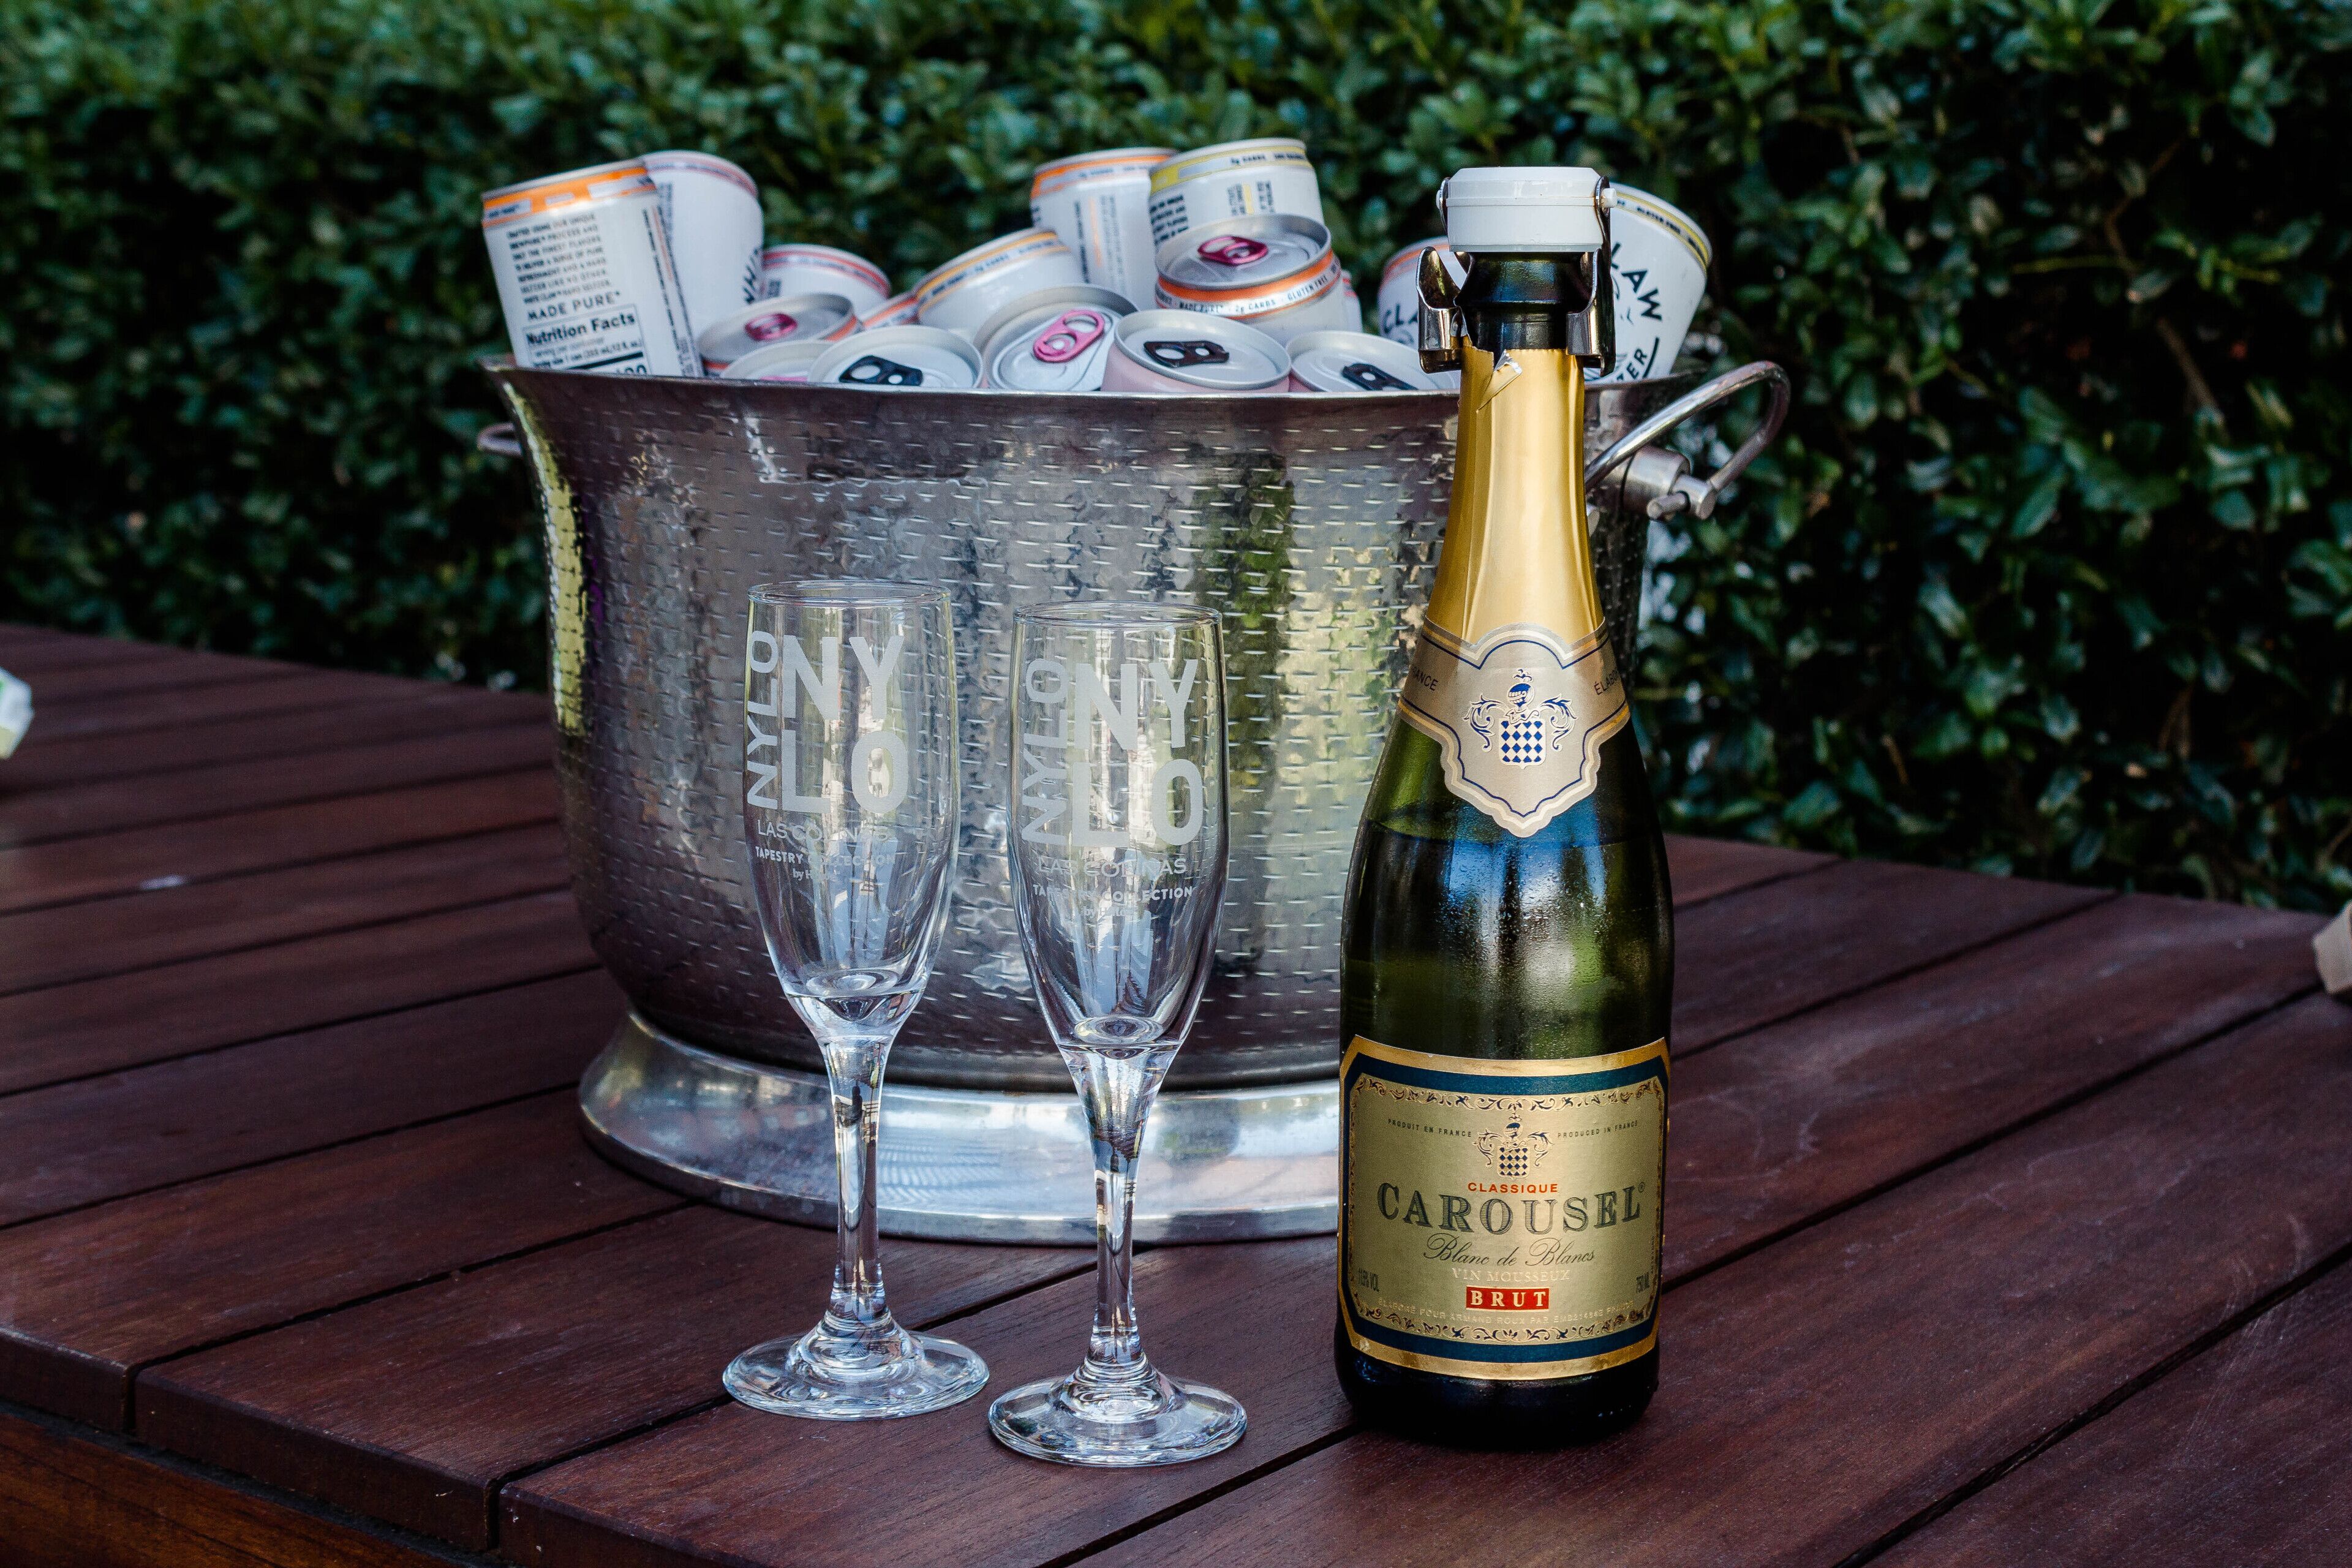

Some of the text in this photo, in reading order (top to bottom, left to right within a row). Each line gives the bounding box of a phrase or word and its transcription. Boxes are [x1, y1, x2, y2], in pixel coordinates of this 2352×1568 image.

[1248, 300, 1276, 311] CARBS
[1287, 284, 1314, 301] GLUTEN
[528, 302, 567, 322] MADE
[526, 309, 636, 345] Nutrition Facts
[782, 635, 905, 720] NY
[1075, 659, 1198, 750] NY
[747, 630, 778, 810] NYLO
[1022, 658, 1068, 846] NYLO
[782, 729, 908, 814] LO
[1072, 759, 1203, 848] LO
[757, 820, 787, 839] LAS
[755, 846, 803, 864] TAPESTRY
[1388, 1118, 1420, 1131] PRODUIT
[1438, 1128, 1471, 1137] FRANCE
[1558, 1128, 1600, 1138] PRODUCED
[1615, 1120, 1638, 1131] FRANCE
[1468, 1182, 1558, 1194] CLASSIQUE
[1423, 1232, 1596, 1267] Blanc de Blancs
[1451, 1267, 1570, 1283] VIN MOUSSEUX
[1470, 1290, 1546, 1307] BRUT
